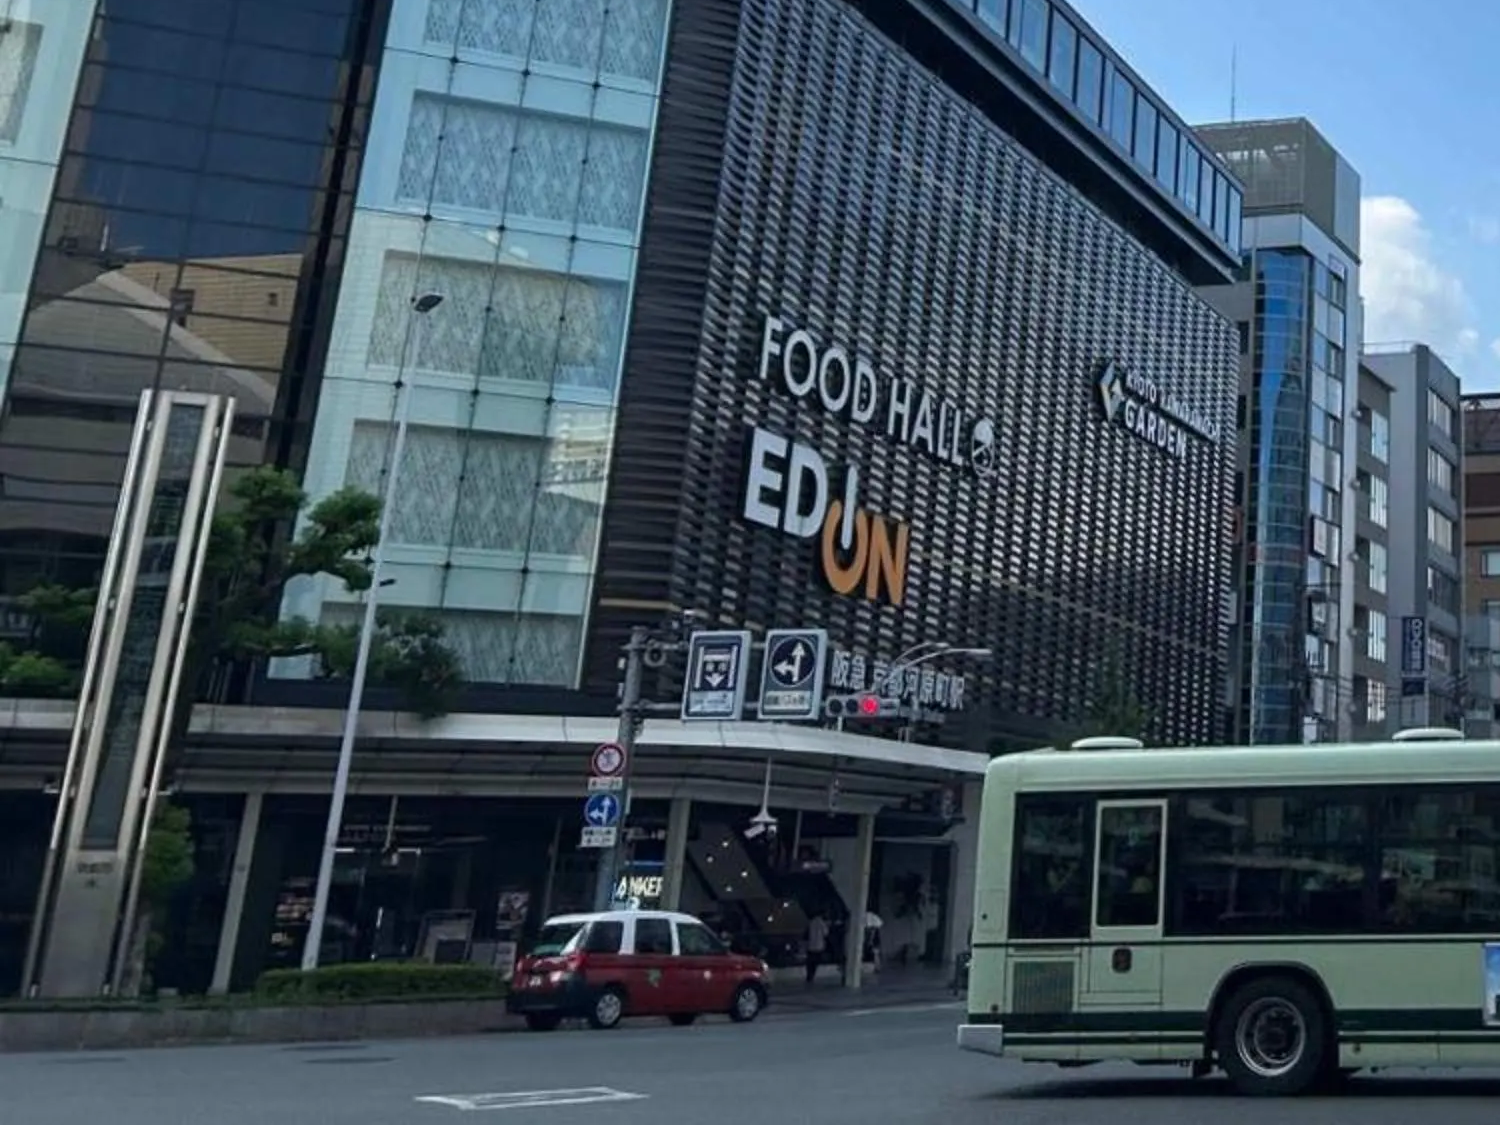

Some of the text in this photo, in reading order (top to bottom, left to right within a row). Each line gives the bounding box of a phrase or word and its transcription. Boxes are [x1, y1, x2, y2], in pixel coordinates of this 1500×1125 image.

[760, 316, 963, 466] FOOD HALL
[1125, 398, 1187, 458] GARDEN
[744, 427, 909, 605] EDION
